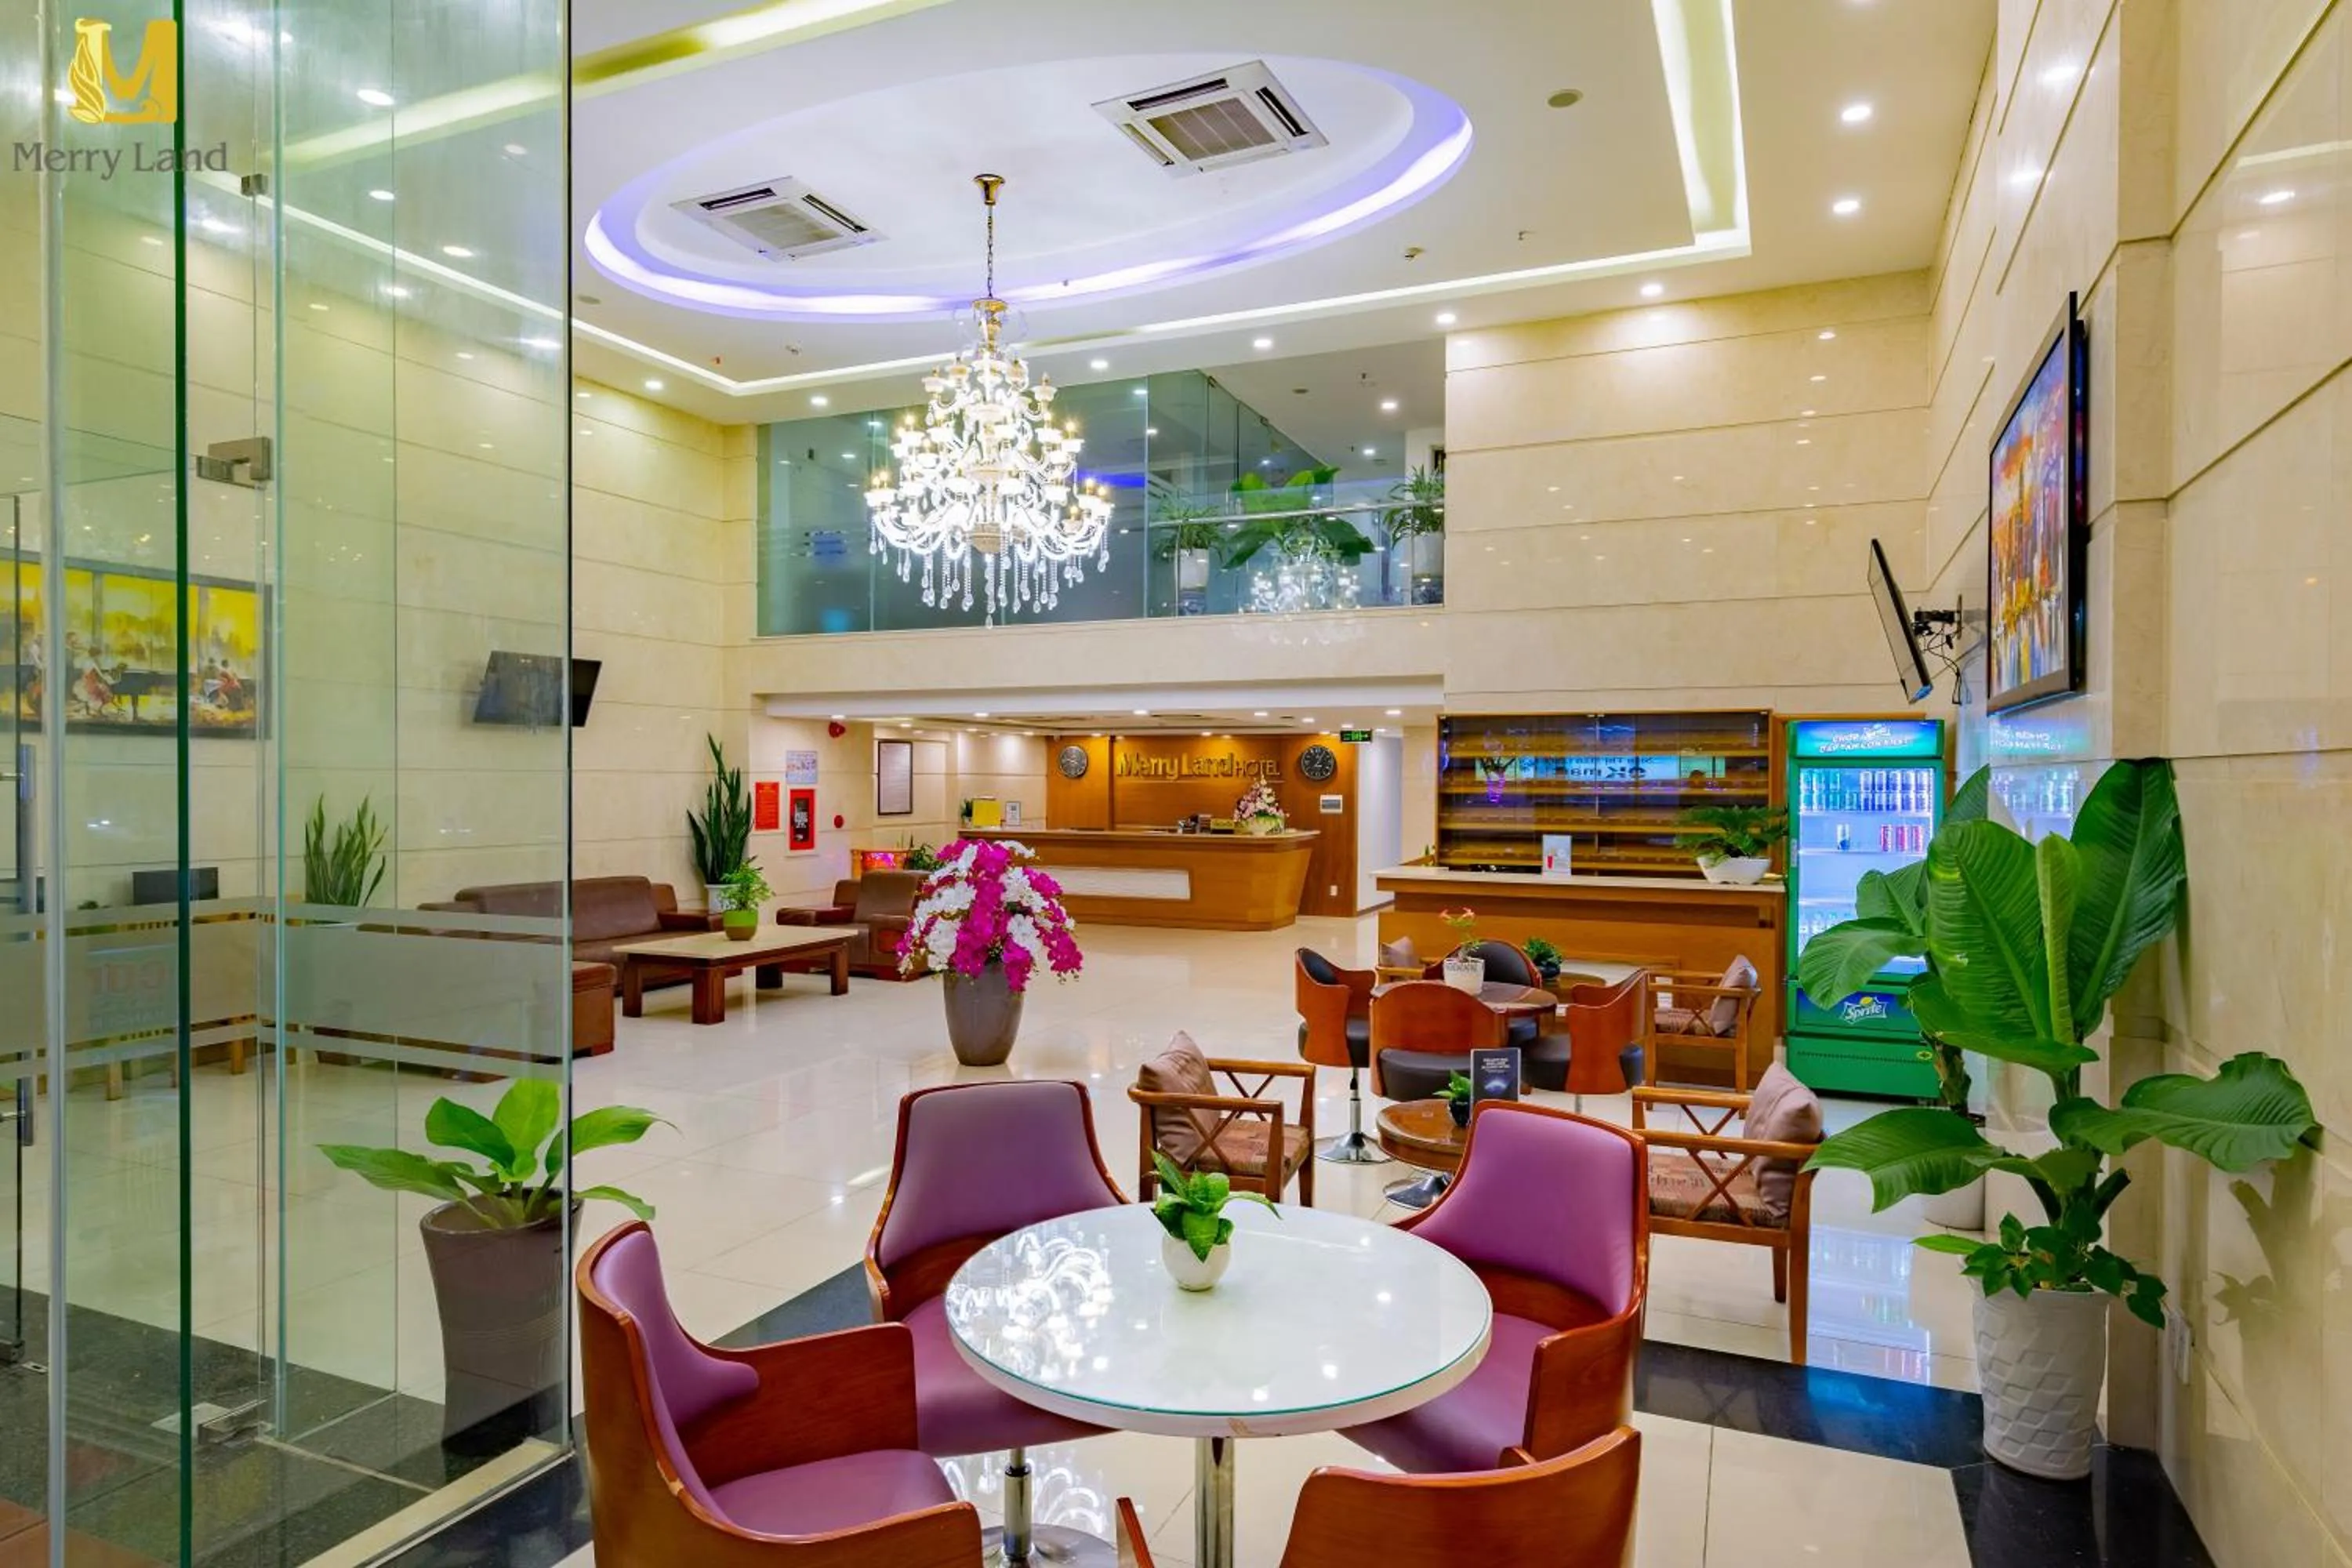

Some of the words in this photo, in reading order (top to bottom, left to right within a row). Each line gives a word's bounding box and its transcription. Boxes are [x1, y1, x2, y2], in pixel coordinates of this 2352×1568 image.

[1117, 752, 1178, 779] Merry
[1181, 752, 1234, 777] Land
[1235, 758, 1280, 776] HOTEL
